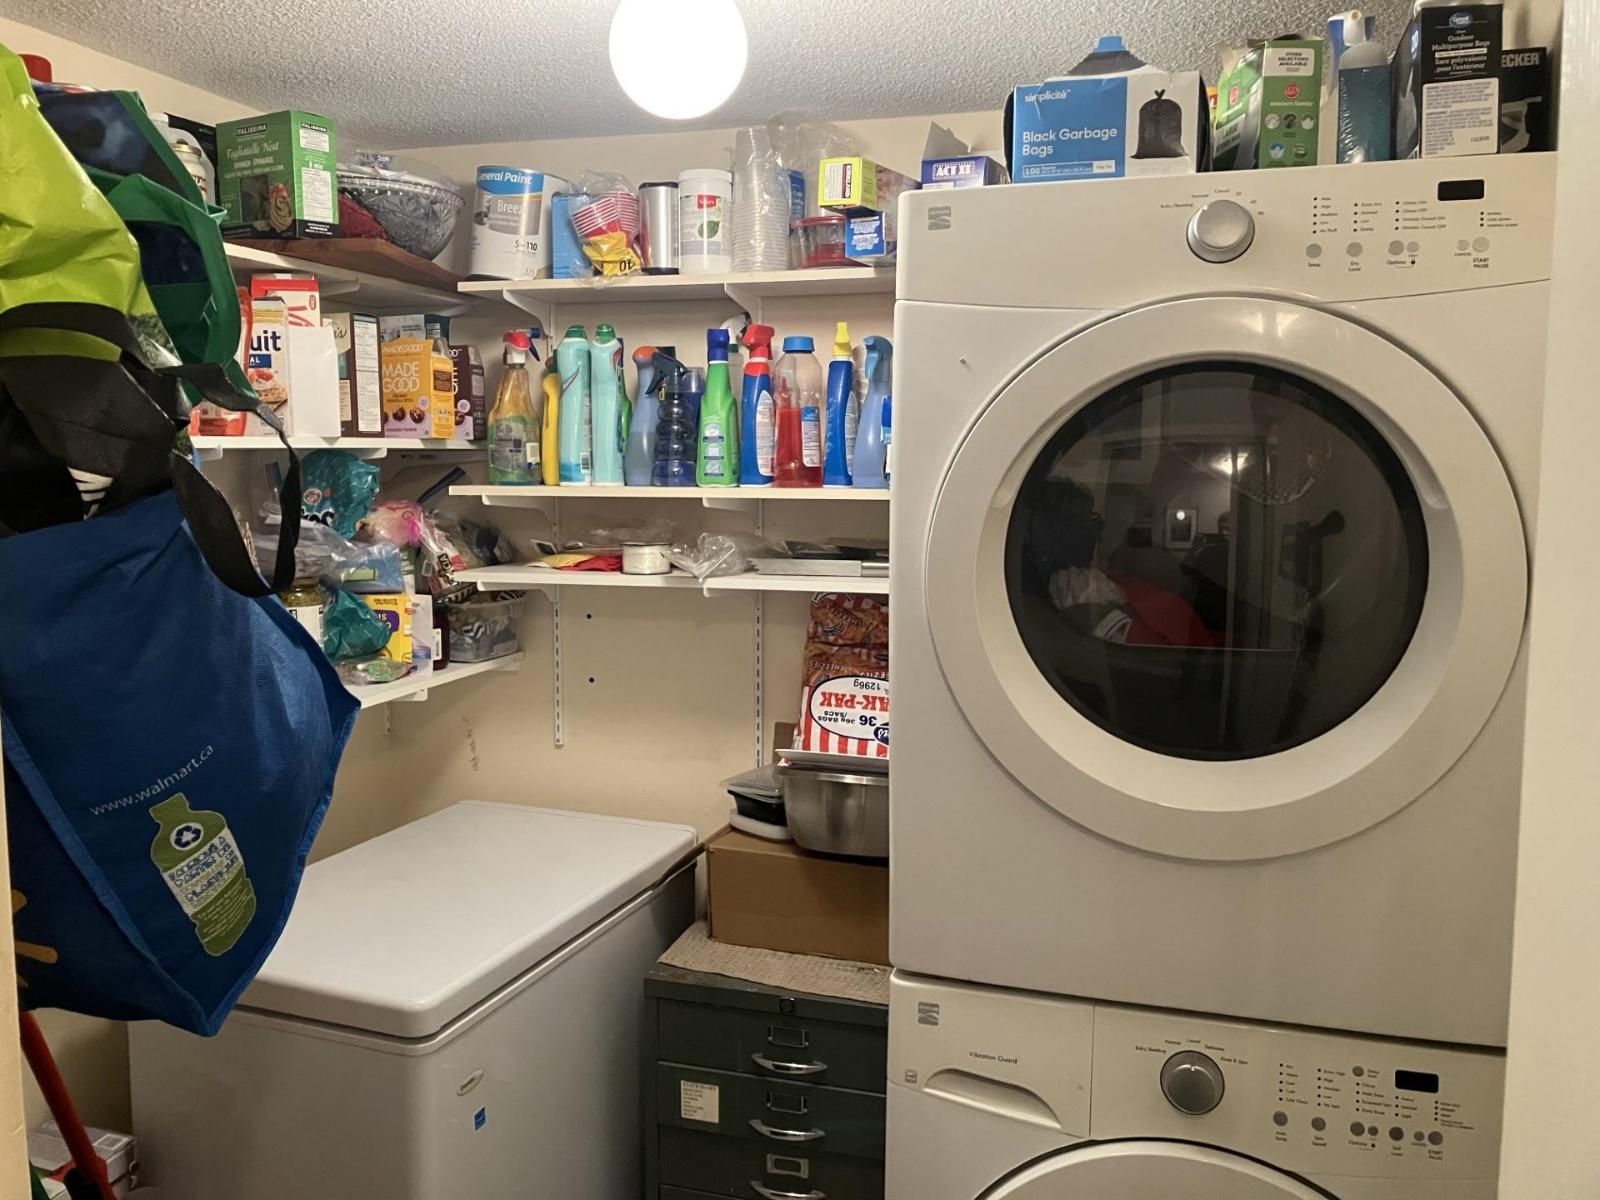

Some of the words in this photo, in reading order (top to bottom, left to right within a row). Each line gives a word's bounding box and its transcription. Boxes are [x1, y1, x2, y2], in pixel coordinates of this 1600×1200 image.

[1502, 53, 1540, 68] ECKER
[1024, 90, 1067, 102] simplicité
[1022, 130, 1056, 144] Black
[1058, 127, 1118, 144] Garbage
[1022, 144, 1054, 158] Bags
[505, 172, 534, 185] Paint
[497, 200, 520, 213] Bree
[250, 330, 282, 351] uit
[382, 362, 420, 378] MADE
[382, 376, 420, 392] GOOD
[854, 678, 881, 692] 1296g
[820, 691, 889, 713] AK-PAK
[818, 716, 838, 724] BAGS
[859, 714, 877, 726] 36
[90, 744, 214, 816] www.walmart.ca
[968, 1050, 996, 1062] Vibration
[998, 1055, 1018, 1064] Guard
